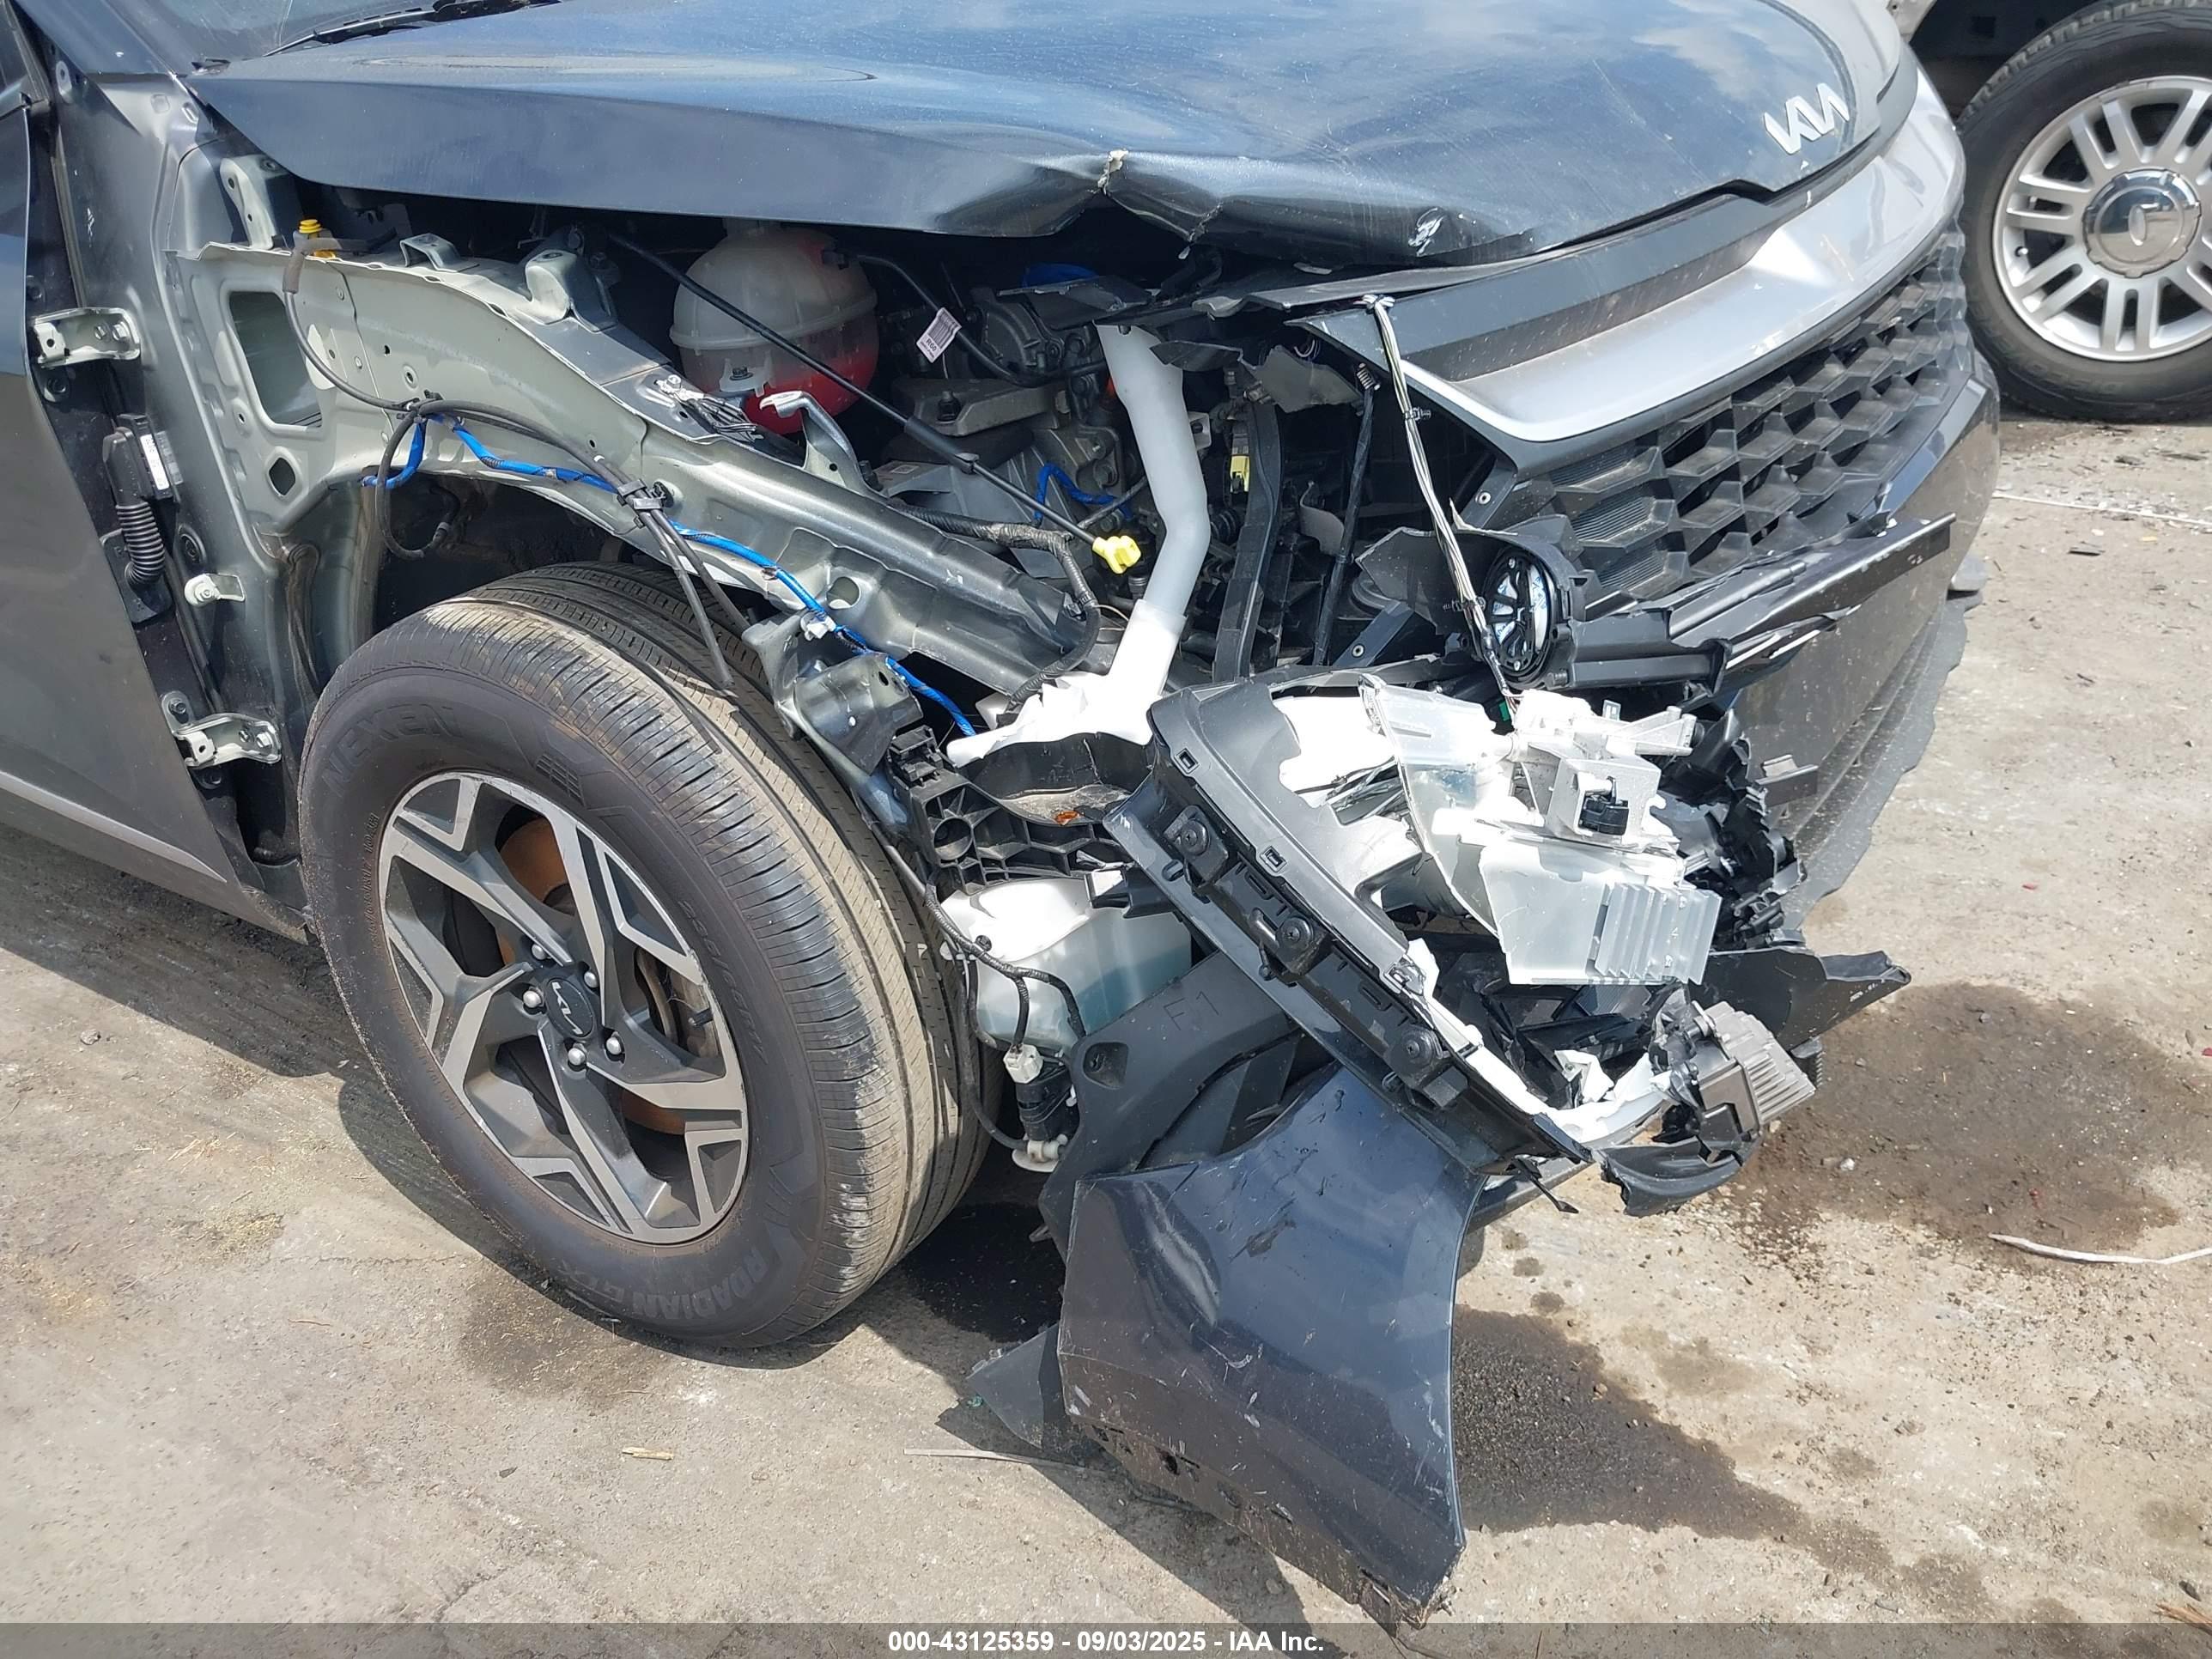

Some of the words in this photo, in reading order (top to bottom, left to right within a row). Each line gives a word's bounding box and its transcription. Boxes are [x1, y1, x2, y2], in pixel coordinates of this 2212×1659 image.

[1763, 82, 1850, 155] KIA
[320, 702, 465, 799] NEXEN
[551, 981, 584, 1035] KIA
[632, 1244, 769, 1319] ROADIAN
